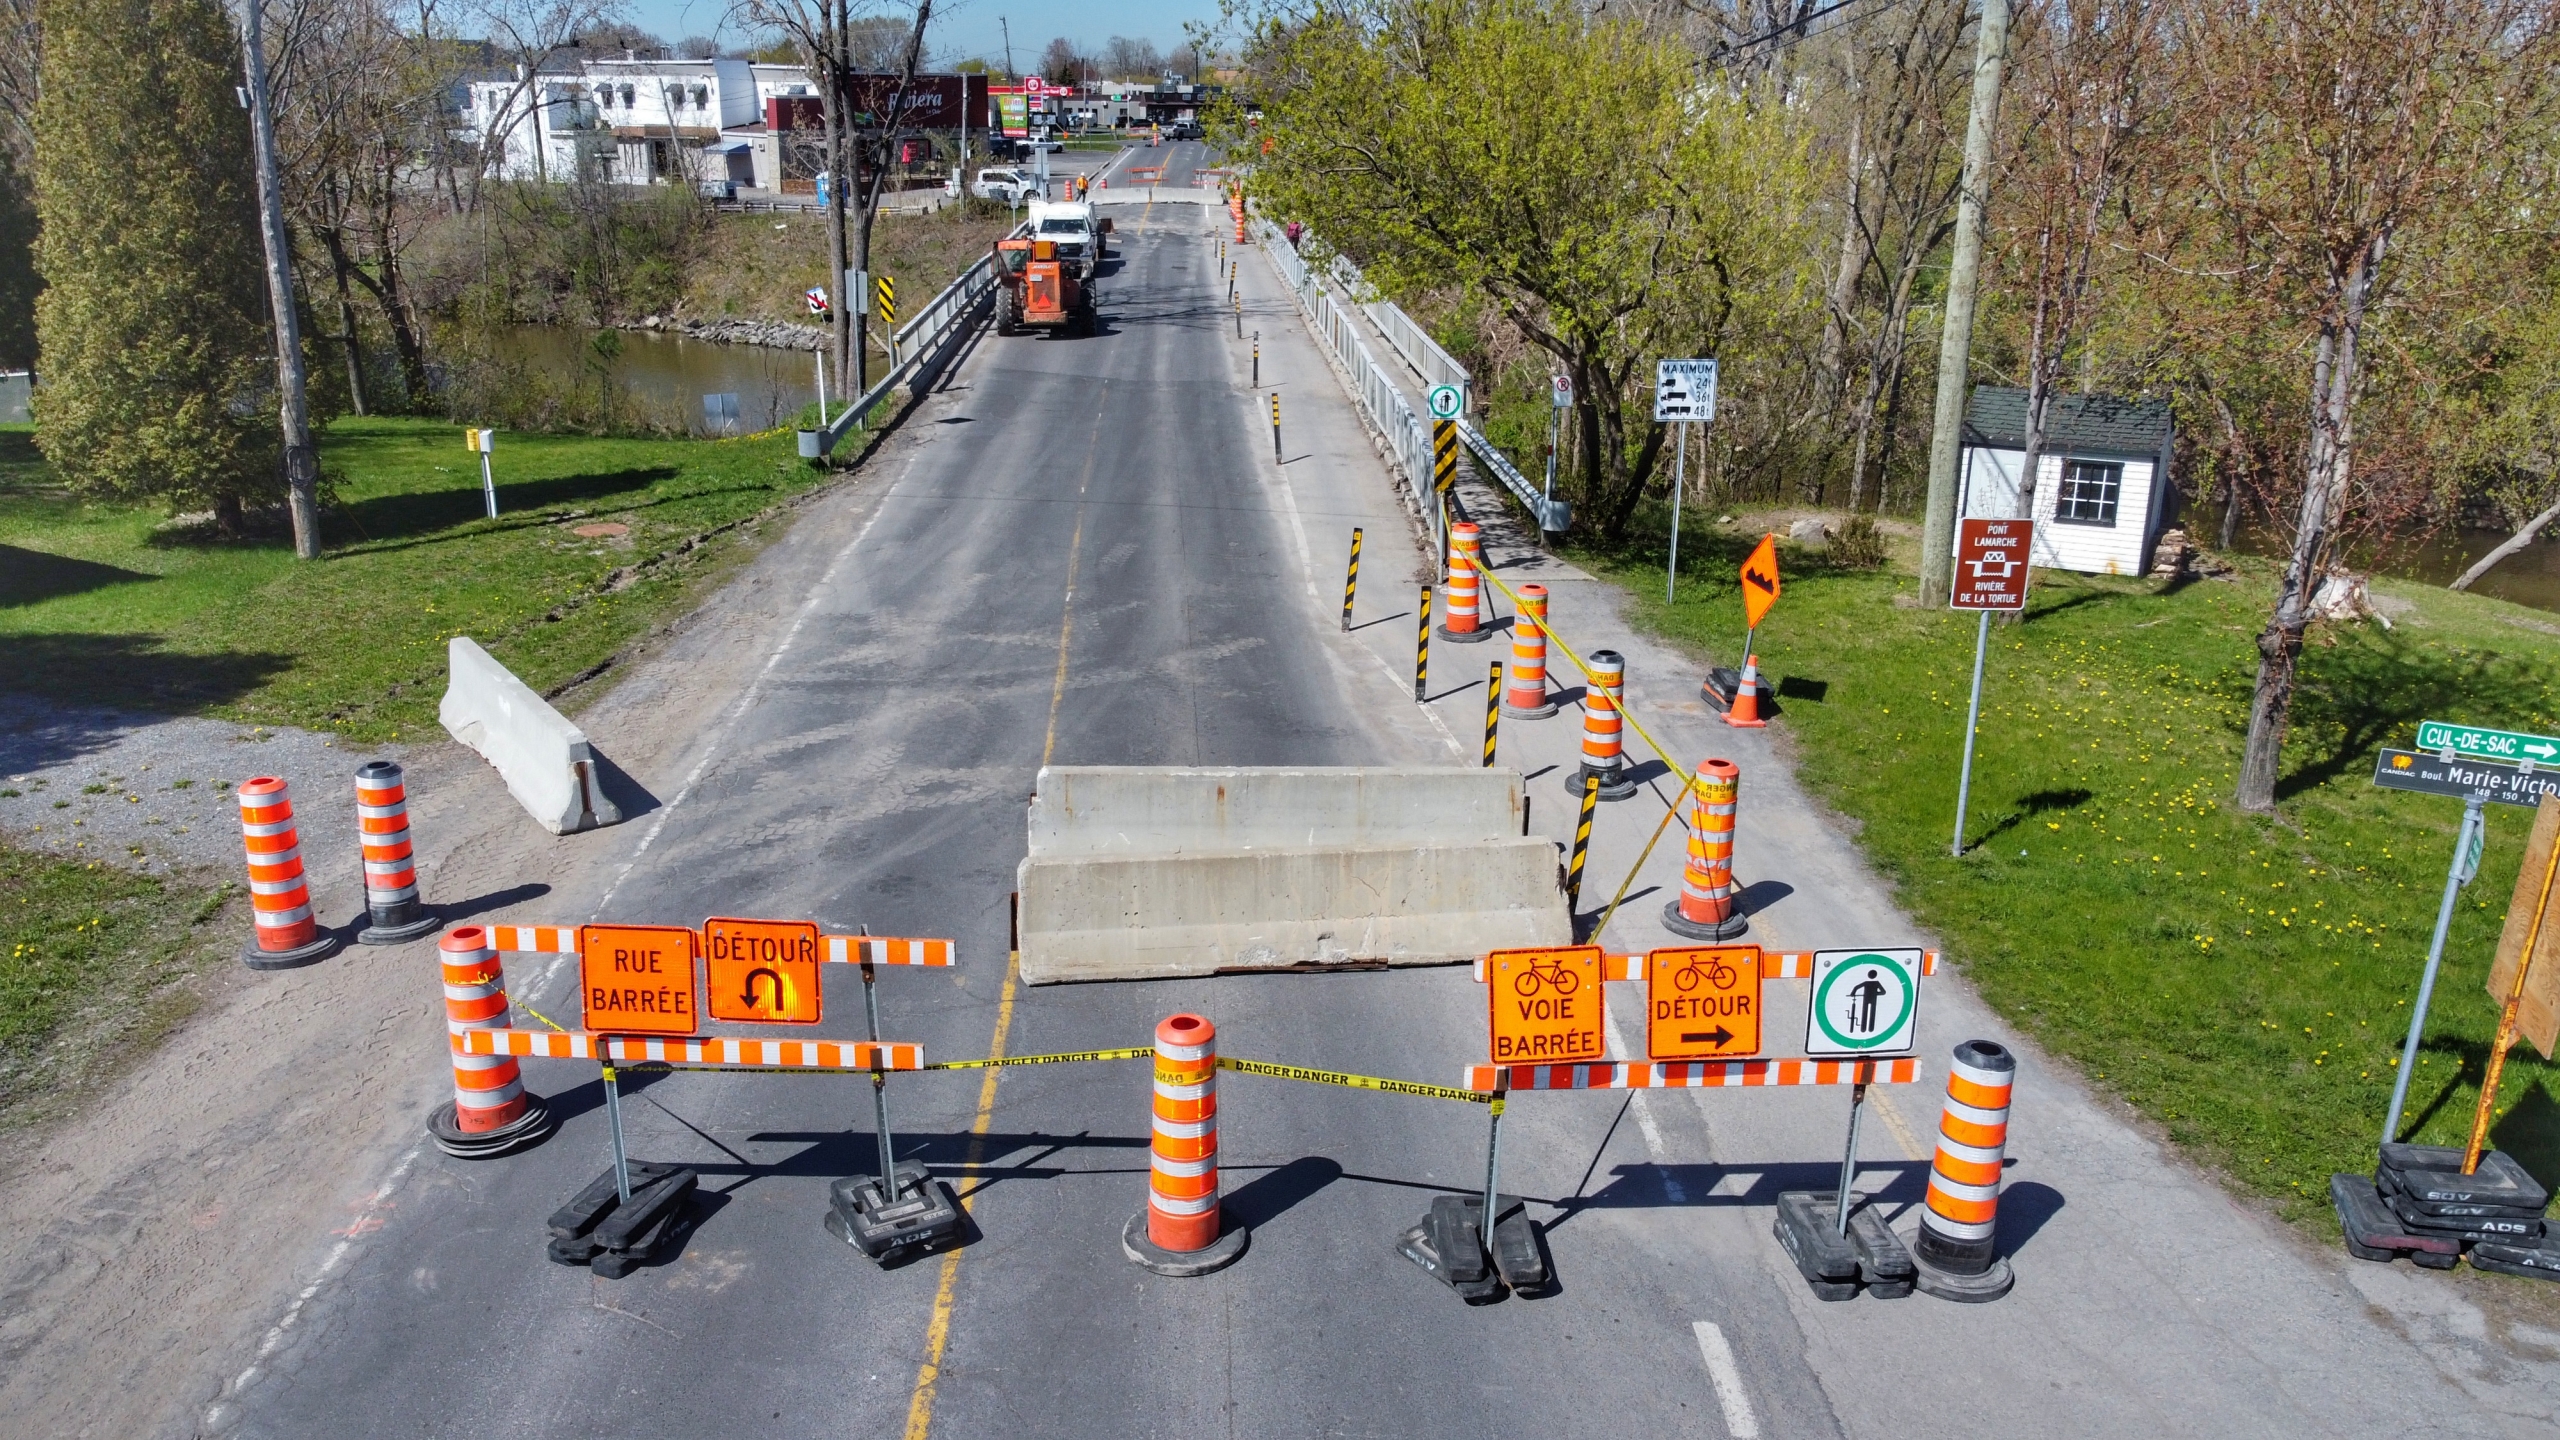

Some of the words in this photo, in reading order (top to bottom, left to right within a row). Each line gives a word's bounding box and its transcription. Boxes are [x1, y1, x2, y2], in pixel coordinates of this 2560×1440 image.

[888, 90, 942, 111] Rviera
[1662, 364, 1713, 374] MAXIMUM
[1987, 525, 2009, 535] PONT
[1974, 537, 2018, 547] LAMARCHE
[1975, 581, 2007, 592] RIVIÈRE
[1960, 593, 1972, 603] DE
[1974, 594, 1986, 603] LA
[1988, 594, 2018, 604] TORTUE
[2426, 727, 2517, 755] CUL-DE-SAC
[2381, 768, 2416, 777] CANDIAC
[2421, 770, 2444, 781] Boul.
[2447, 767, 2560, 797] Marie-Victo
[2474, 788, 2491, 797] 148
[2502, 791, 2518, 801] 150
[713, 931, 814, 963] DÉTOUR
[614, 949, 663, 973] RUE
[592, 986, 689, 1014] BARRÉE
[1657, 995, 1751, 1020] DÉTOUR
[1517, 998, 1574, 1021] VOIE
[1497, 1028, 1595, 1057] BARRÉE
[982, 1057, 1039, 1068] DANGER
[1043, 1052, 1100, 1064] DANGER
[1235, 1060, 1290, 1078] DANGER
[1293, 1069, 1349, 1085] DANGER
[1380, 1080, 1436, 1097] DANGER
[2481, 1222, 2527, 1233] ADS
[890, 1230, 932, 1247] ADS
